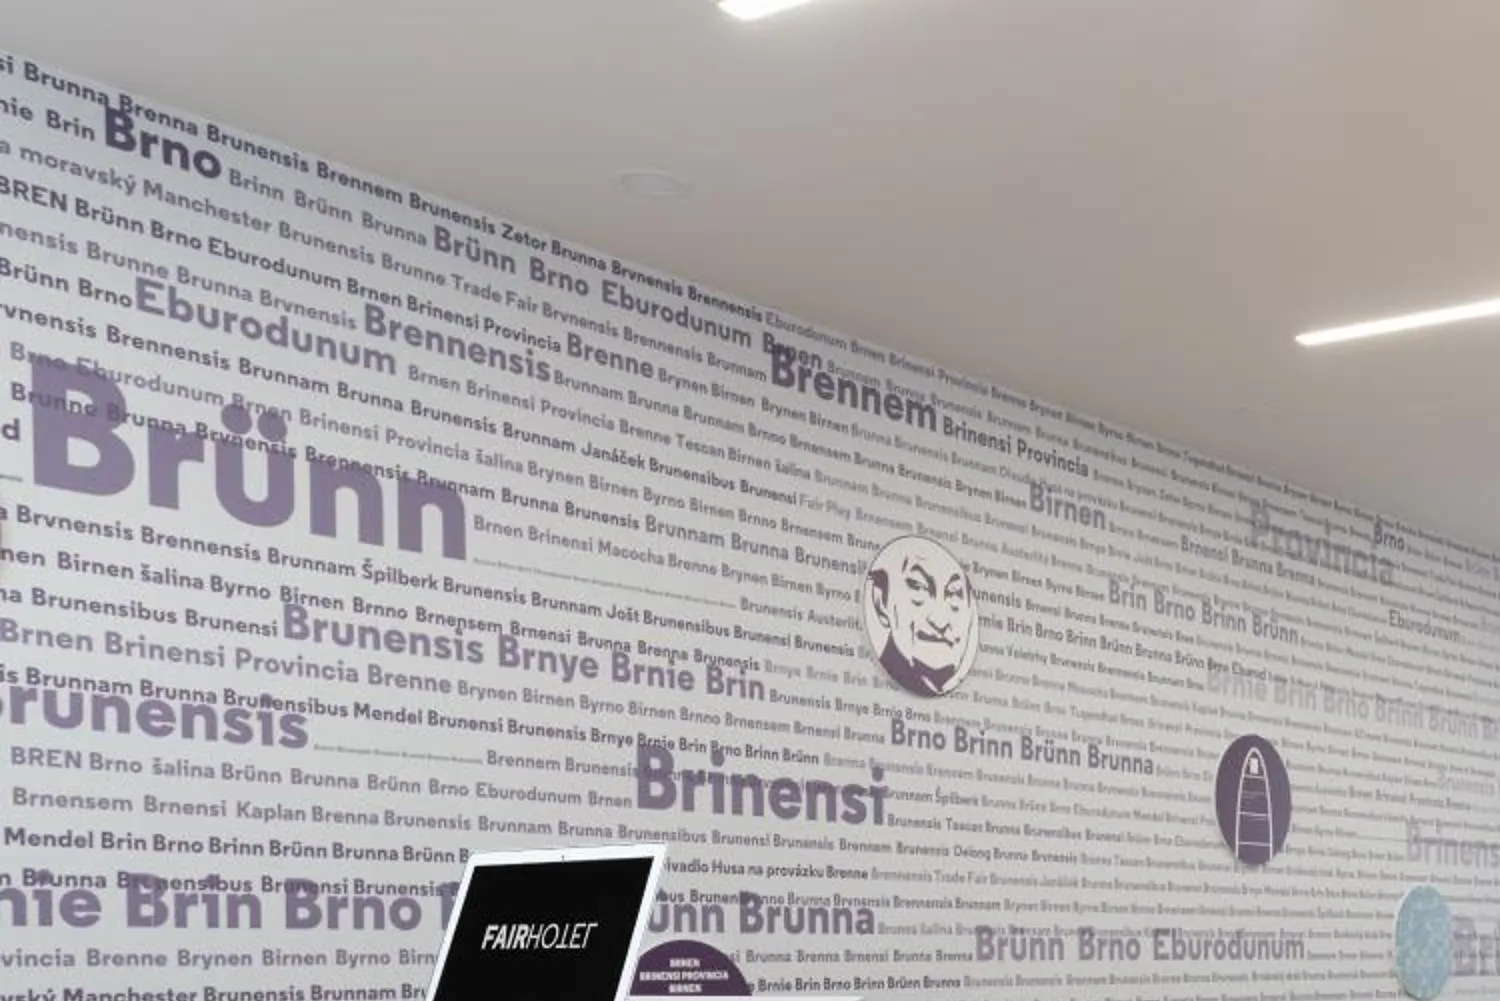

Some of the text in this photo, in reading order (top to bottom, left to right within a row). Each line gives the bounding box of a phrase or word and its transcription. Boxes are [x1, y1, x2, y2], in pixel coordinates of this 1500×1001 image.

[23, 61, 547, 252] Brunna Brenna Brunensis Brennem Brunensis Zetor
[45, 105, 284, 201] Brin Brno Brinn
[19, 147, 375, 265] moravský Manchester Brunensis
[75, 196, 402, 308] Brünn Brno Eburodunum Brnen
[176, 264, 253, 302] Brunna
[434, 224, 516, 275] Brünn
[529, 255, 589, 297] Brno
[601, 278, 751, 348] Eburodunum
[450, 273, 538, 313] Trade Fair
[0, 256, 396, 375] Brünn Brno Eburodunum
[364, 302, 551, 382] Brennensis
[567, 331, 654, 379] Brenne
[76, 355, 225, 408] Eburodunum
[106, 323, 497, 434] Brennensis Brunnam Brunna Brunensis
[299, 407, 470, 461] Brinensi Provincia
[771, 342, 1089, 477] Brennem Brinensi Provincia
[32, 355, 466, 560] Brünn
[580, 441, 645, 470] Janáček
[501, 486, 789, 561] Brunna Brunensis Brunnam Brunna
[1028, 483, 1106, 531] Birnen
[1374, 522, 1406, 550] Brno
[57, 550, 134, 580] Birnen
[140, 524, 261, 562] Brennensis
[267, 546, 356, 577] Brunnam
[361, 557, 438, 591] Špilberk
[442, 575, 527, 605] Brunensis
[530, 590, 602, 617] Brunnam
[210, 574, 344, 611] Byrno Birnen
[1108, 578, 1299, 645] Brin Brno Brinn Brünn
[0, 616, 452, 694] Brnen Brinensi Provincia Brenne
[31, 586, 764, 700] Brunensibus Brunensi Brunensis Brnye Brnie Brin
[25, 666, 217, 705] Brunnam Brunna
[353, 701, 587, 742] Mendel Brunensi Brunensis
[678, 736, 707, 753] Brin
[890, 713, 1154, 775] Brno Brinn Brünn Brunna
[11, 745, 469, 797] BREN Brno šalina Brünn Brunna Brünn Brno
[636, 745, 888, 827] Brinensi
[12, 785, 307, 823] Brnensem Brnensi Kaplan
[383, 808, 471, 831] Brunensis
[3, 826, 455, 863] Mendel Brin Brno Brinn Brünn Brunna Brünn
[662, 857, 824, 879] ivadlo Husa na provázku
[125, 872, 263, 929] Brin
[284, 877, 423, 930] Brno
[739, 891, 875, 935] Brunna
[177, 947, 391, 971] Brynen Birnen Byrno
[975, 924, 1305, 962] Brünn Brno Eburodunum
[310, 983, 396, 1001] Brunnam
[794, 976, 821, 992] Brin
